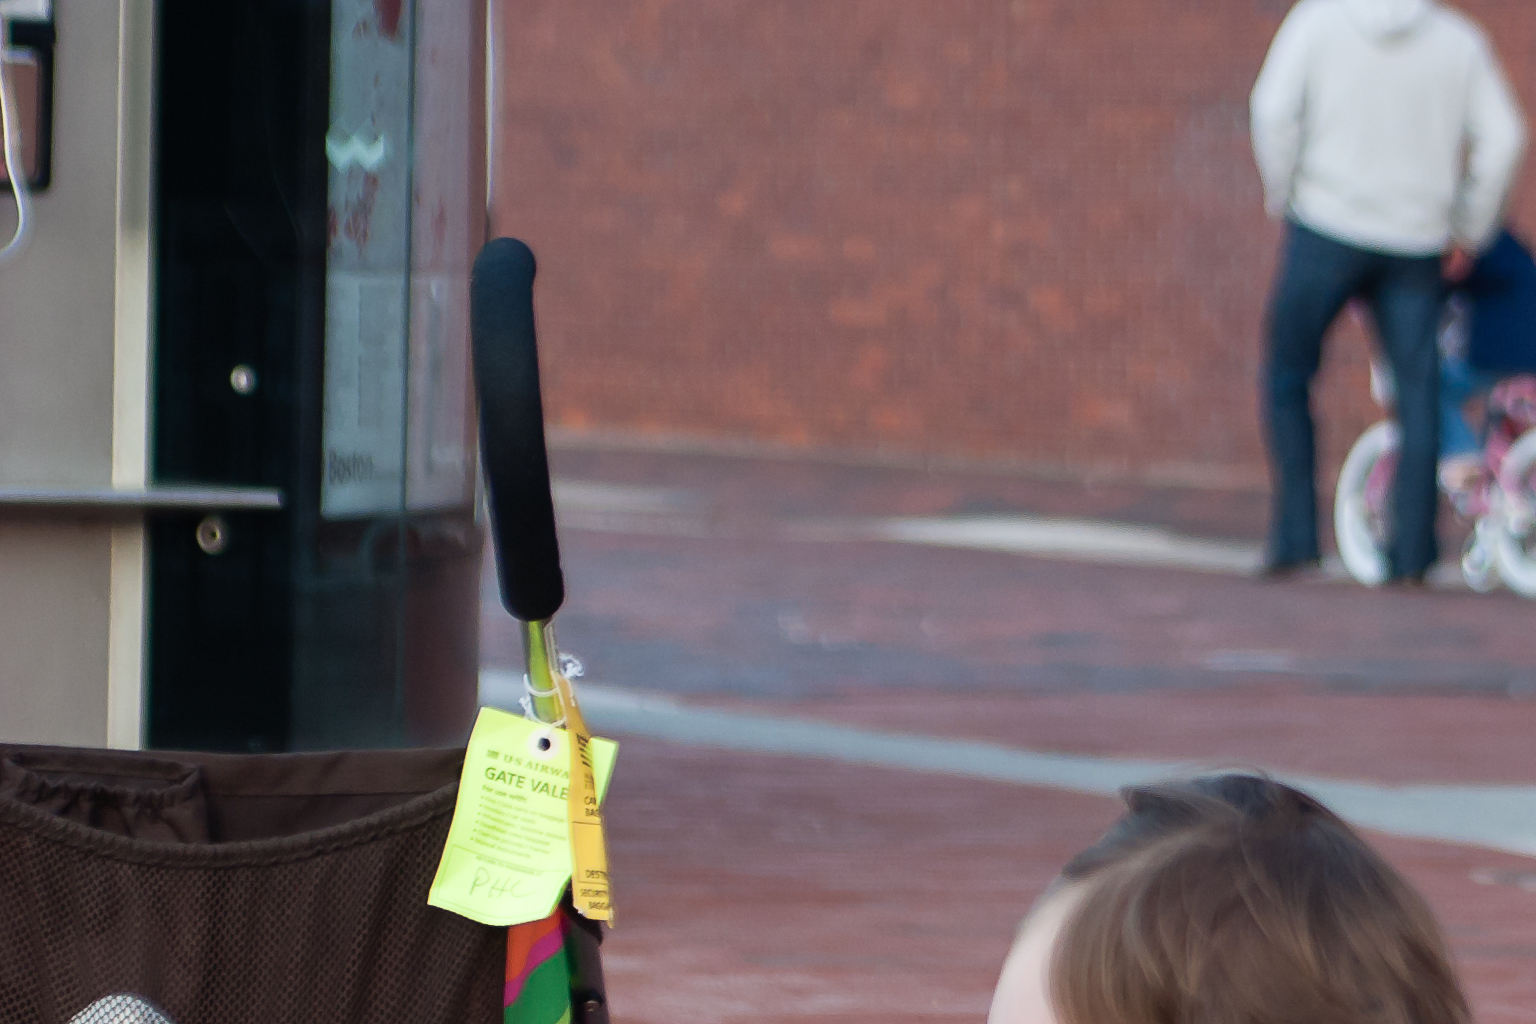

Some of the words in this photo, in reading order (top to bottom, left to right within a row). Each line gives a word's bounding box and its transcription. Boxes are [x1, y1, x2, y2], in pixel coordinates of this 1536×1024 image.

[328, 447, 374, 485] Boston
[485, 766, 526, 789] GATE
[531, 778, 570, 801] VALE
[503, 754, 522, 766] US
[525, 761, 569, 779] AIRWA
